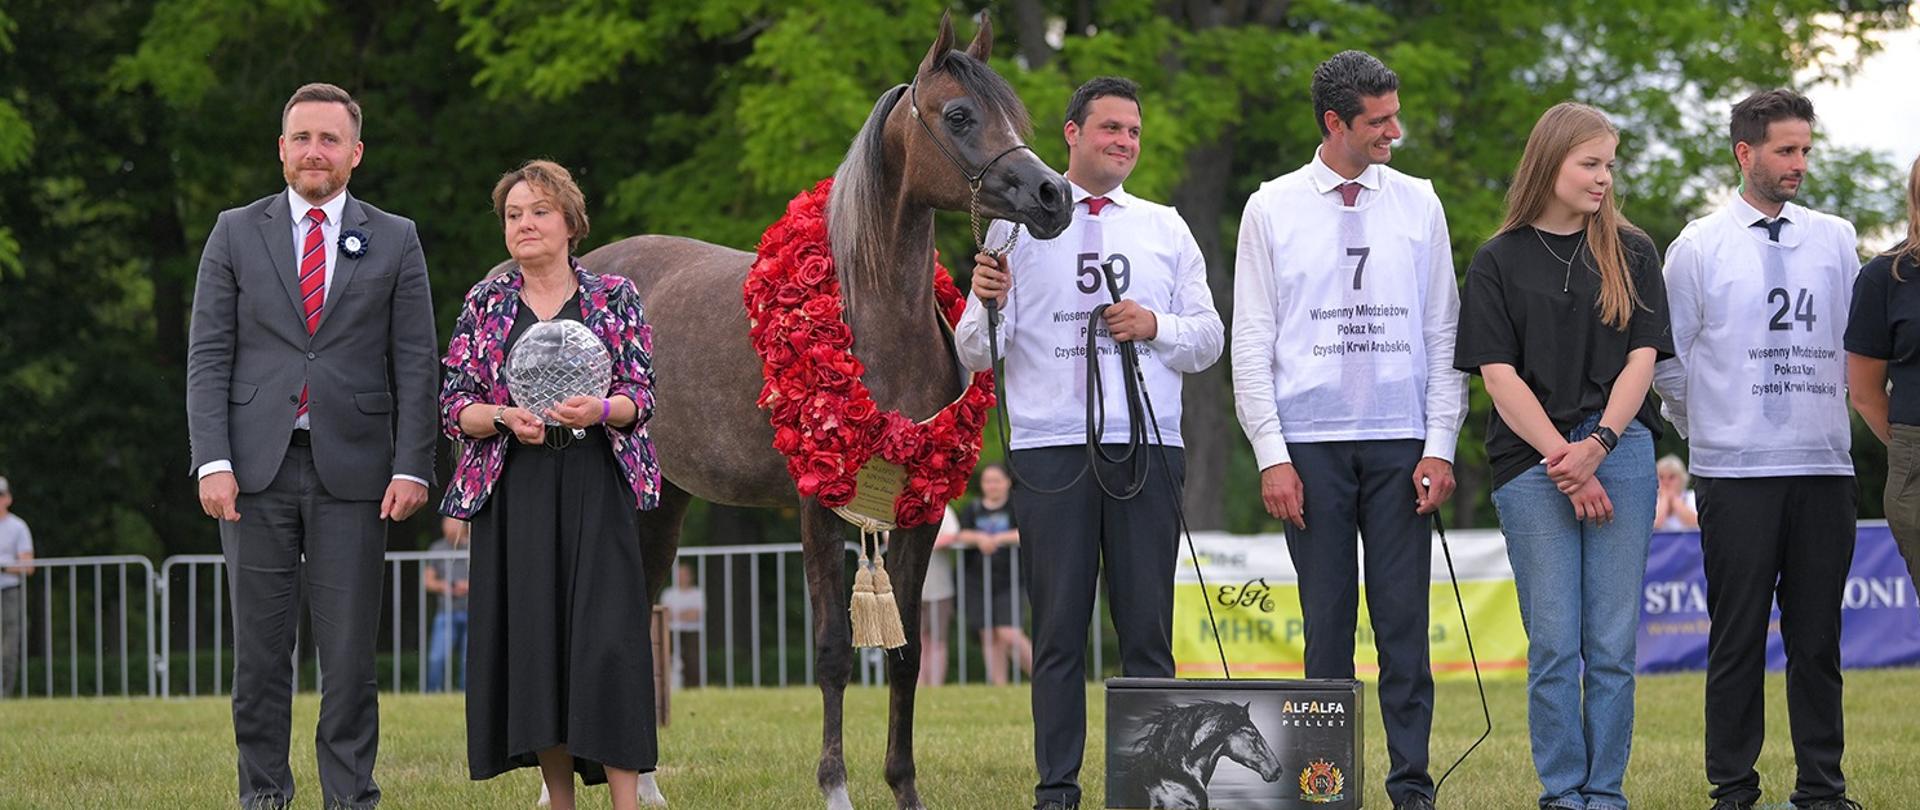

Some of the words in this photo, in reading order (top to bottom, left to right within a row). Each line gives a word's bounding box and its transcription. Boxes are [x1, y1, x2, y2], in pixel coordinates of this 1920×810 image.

[1076, 252, 1131, 295] 59
[1346, 247, 1370, 290] 7
[1053, 310, 1091, 323] Wiosenn
[1767, 287, 1816, 332] 24
[1081, 327, 1108, 338] Pkaz
[1337, 323, 1366, 335] Pokaz
[1313, 341, 1345, 357] Czystej
[1346, 340, 1369, 352] Krwi
[1748, 348, 1790, 360] Wosenny
[1774, 363, 1801, 375] Pokaz
[1751, 382, 1783, 396] Czystej
[1784, 381, 1806, 393] Krwi
[1200, 618, 1275, 643] MHR
[1282, 700, 1345, 714] ALFALFA
